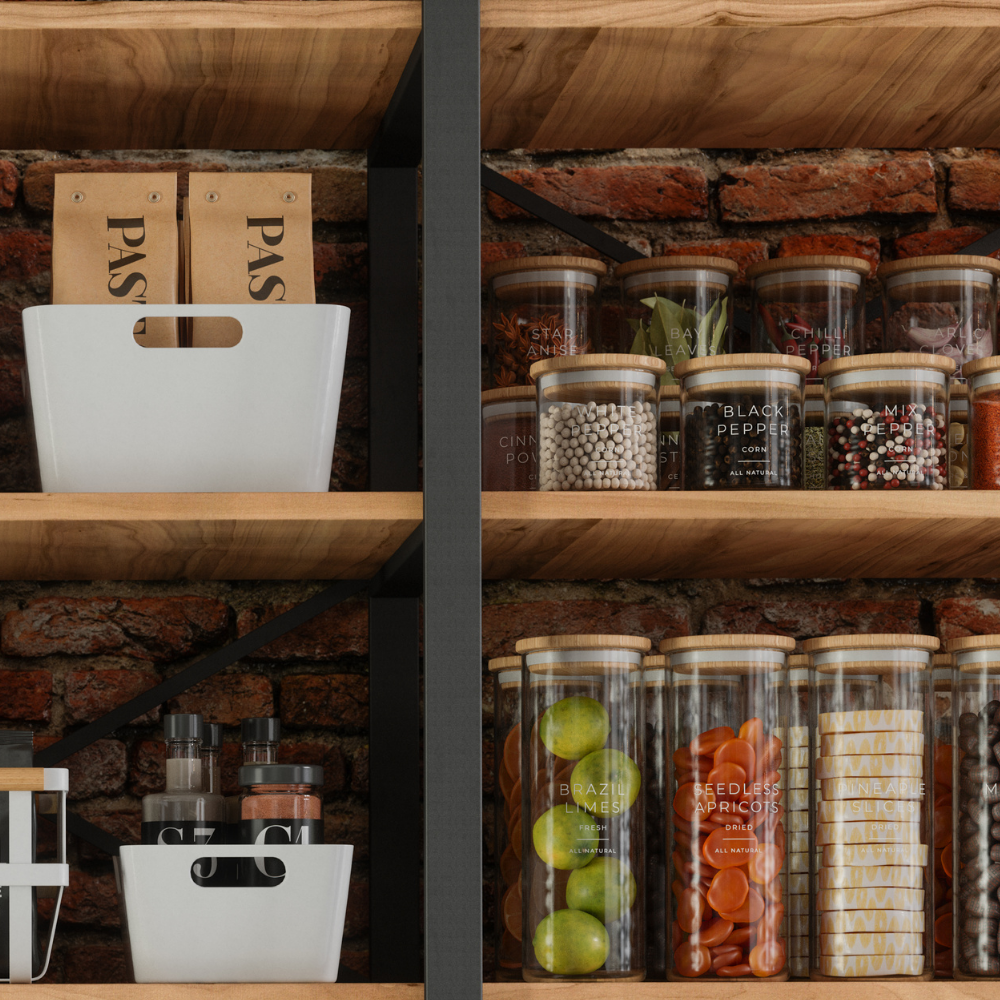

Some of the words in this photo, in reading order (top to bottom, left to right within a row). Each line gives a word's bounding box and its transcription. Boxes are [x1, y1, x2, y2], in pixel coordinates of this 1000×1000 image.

[532, 328, 573, 340] STAR
[670, 328, 703, 339] BAY
[791, 328, 846, 339] CHILLI
[930, 328, 982, 339] ARLC
[526, 345, 577, 356] ANISE
[654, 344, 716, 357] LEAVES
[786, 344, 850, 356] PEPPER
[577, 405, 636, 418] WHITE
[724, 405, 784, 418] BLACK
[885, 405, 917, 416] MIX
[571, 423, 642, 436] PEPPER
[717, 423, 789, 436] PEPPER
[864, 423, 935, 435] PEPPER
[560, 783, 625, 796] BRAZIL
[694, 783, 779, 795] SEEDLESS
[838, 783, 925, 795] PINEAPLE
[566, 802, 620, 813] LIMES
[695, 801, 778, 813] APRICOTS
[852, 801, 915, 812] SLICES
